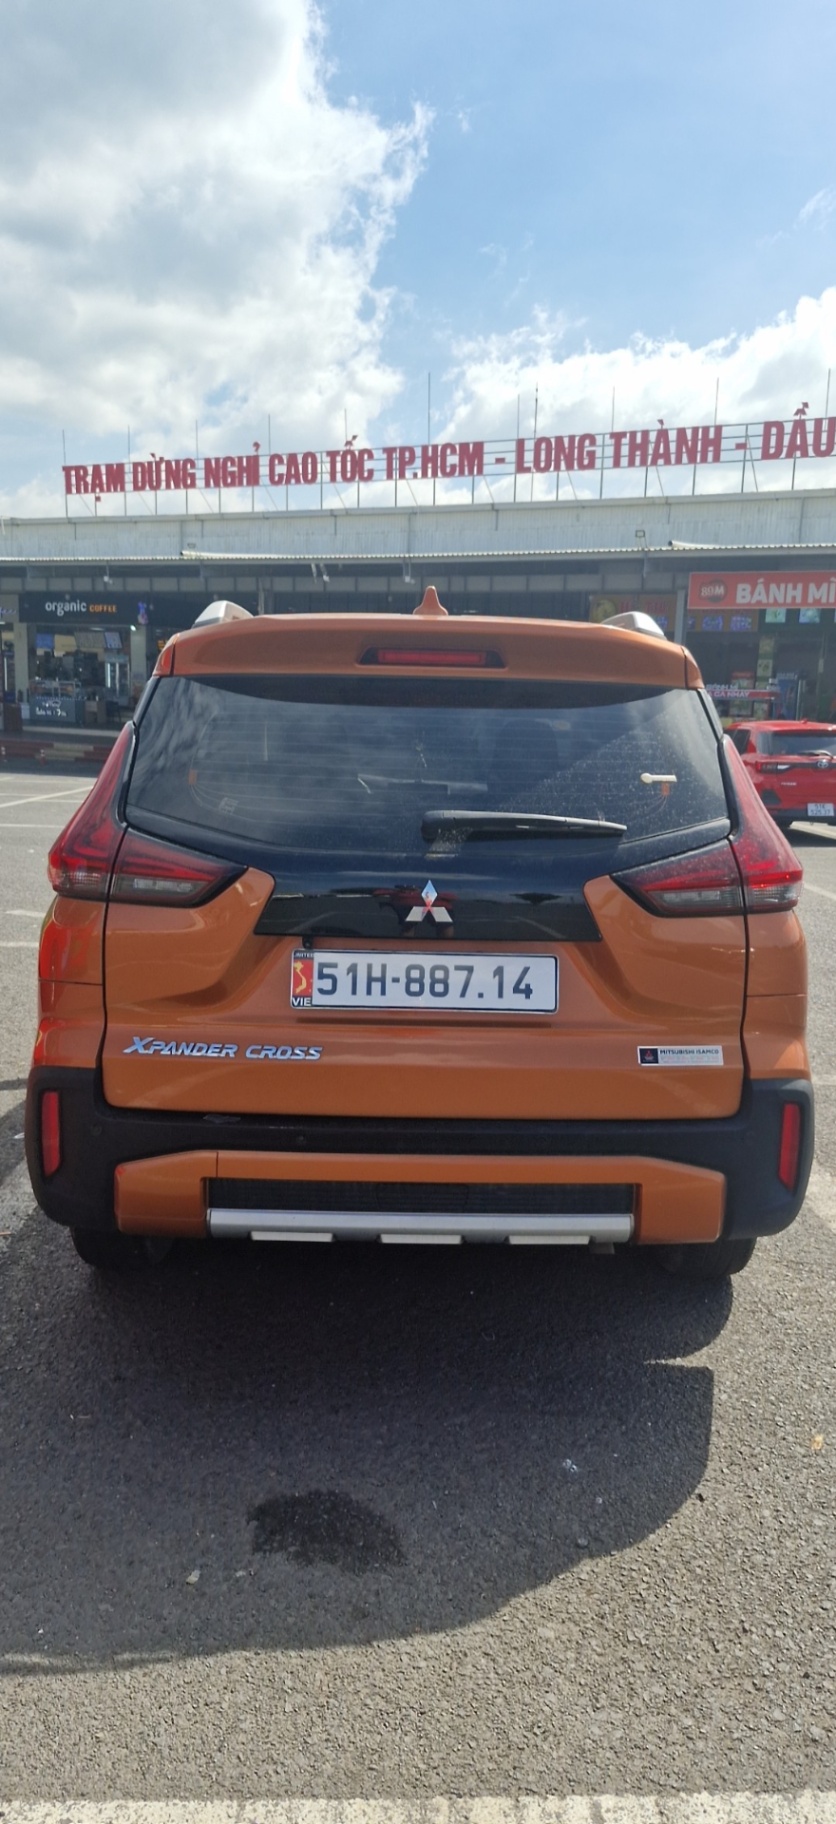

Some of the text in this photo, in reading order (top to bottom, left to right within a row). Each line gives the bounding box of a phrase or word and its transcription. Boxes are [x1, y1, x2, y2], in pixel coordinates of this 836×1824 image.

[62, 463, 126, 502] TRẠM
[132, 453, 197, 491] DỪNG
[204, 442, 260, 488] NGHỈ
[269, 452, 318, 486] CAO
[326, 435, 375, 483] TỐC
[382, 441, 485, 480] TP.HCM
[515, 433, 597, 474] LONG
[609, 419, 723, 468] THÀNH
[736, 578, 803, 604] BÁNH
[45, 600, 117, 616] organic COFFEE
[317, 962, 533, 999] 51H-887.14
[292, 997, 312, 1007] VIE
[123, 1036, 323, 1060] XPANDER CROSS
